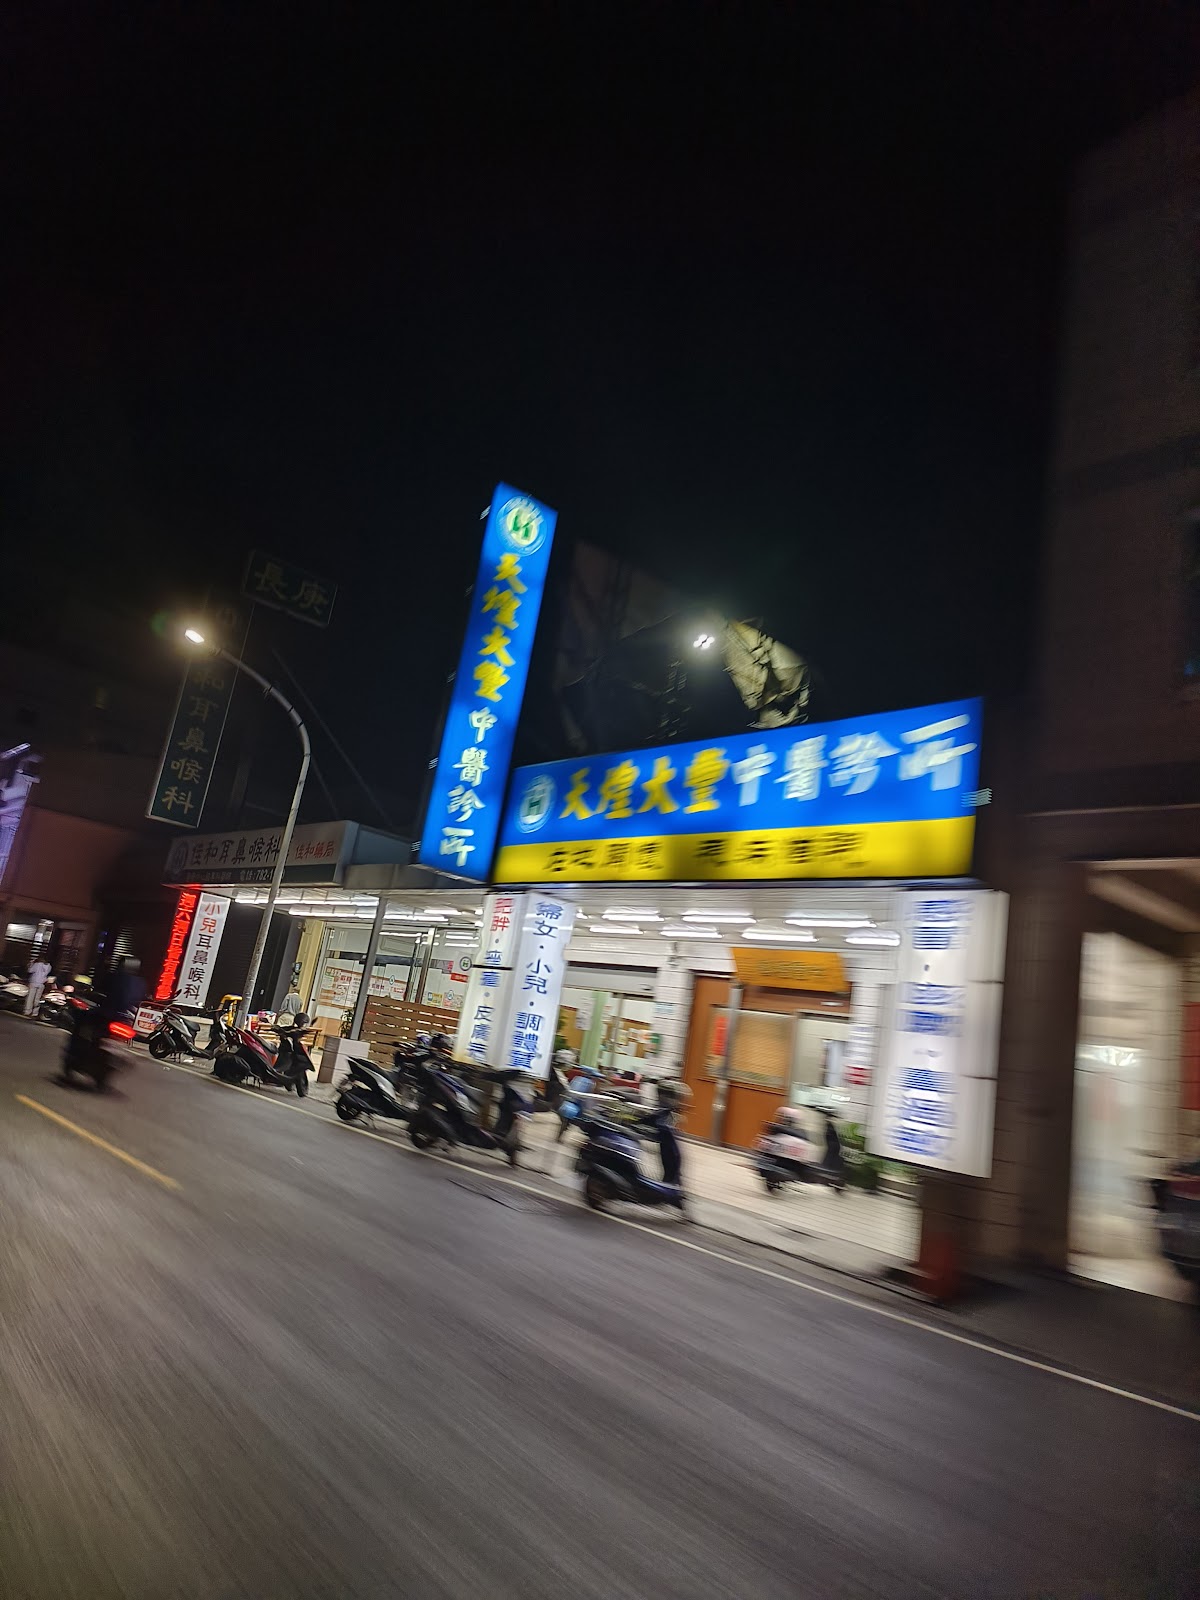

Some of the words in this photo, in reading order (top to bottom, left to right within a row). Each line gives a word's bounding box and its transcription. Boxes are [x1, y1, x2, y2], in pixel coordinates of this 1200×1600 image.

[183, 902, 221, 1000] 小兒耳鼻喉科
